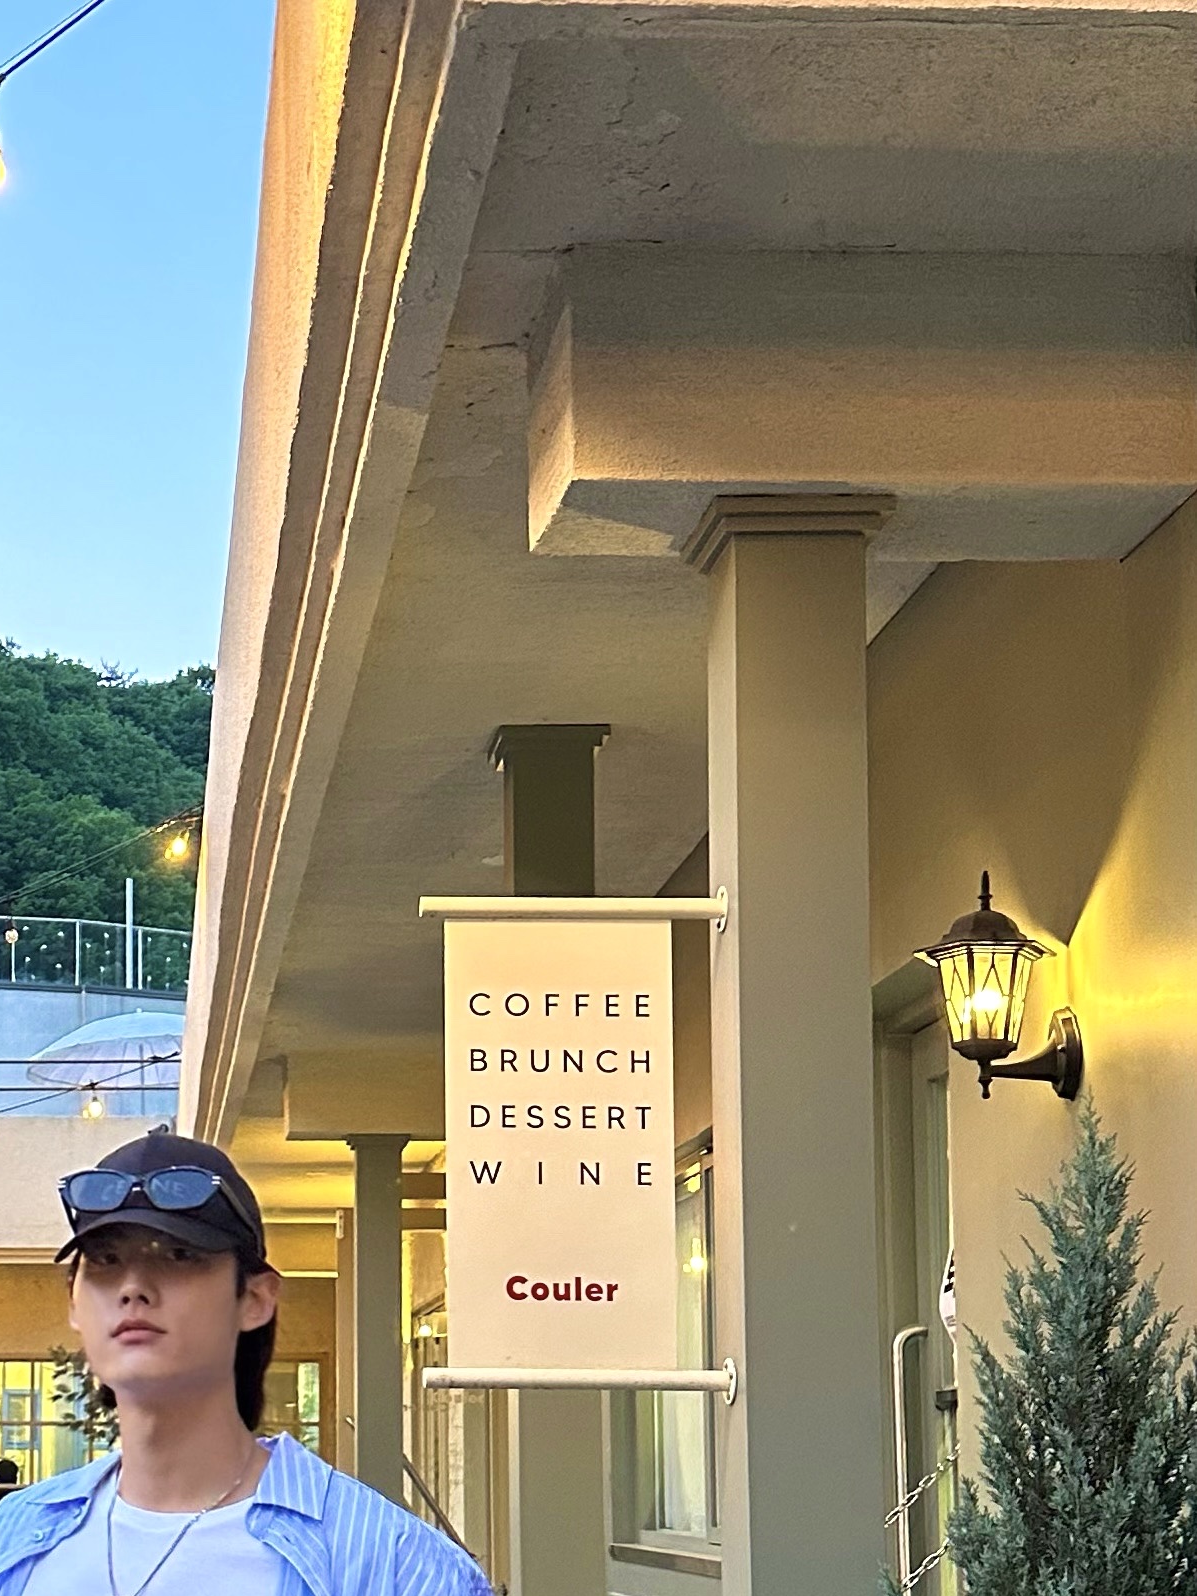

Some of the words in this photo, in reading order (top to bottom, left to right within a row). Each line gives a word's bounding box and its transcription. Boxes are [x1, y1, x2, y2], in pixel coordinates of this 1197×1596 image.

[469, 992, 650, 1018] COFFEE
[470, 1048, 650, 1074] BRUNCH
[470, 1104, 652, 1130] DESSERT
[469, 1160, 653, 1187] WINE
[506, 1275, 619, 1302] Couler
